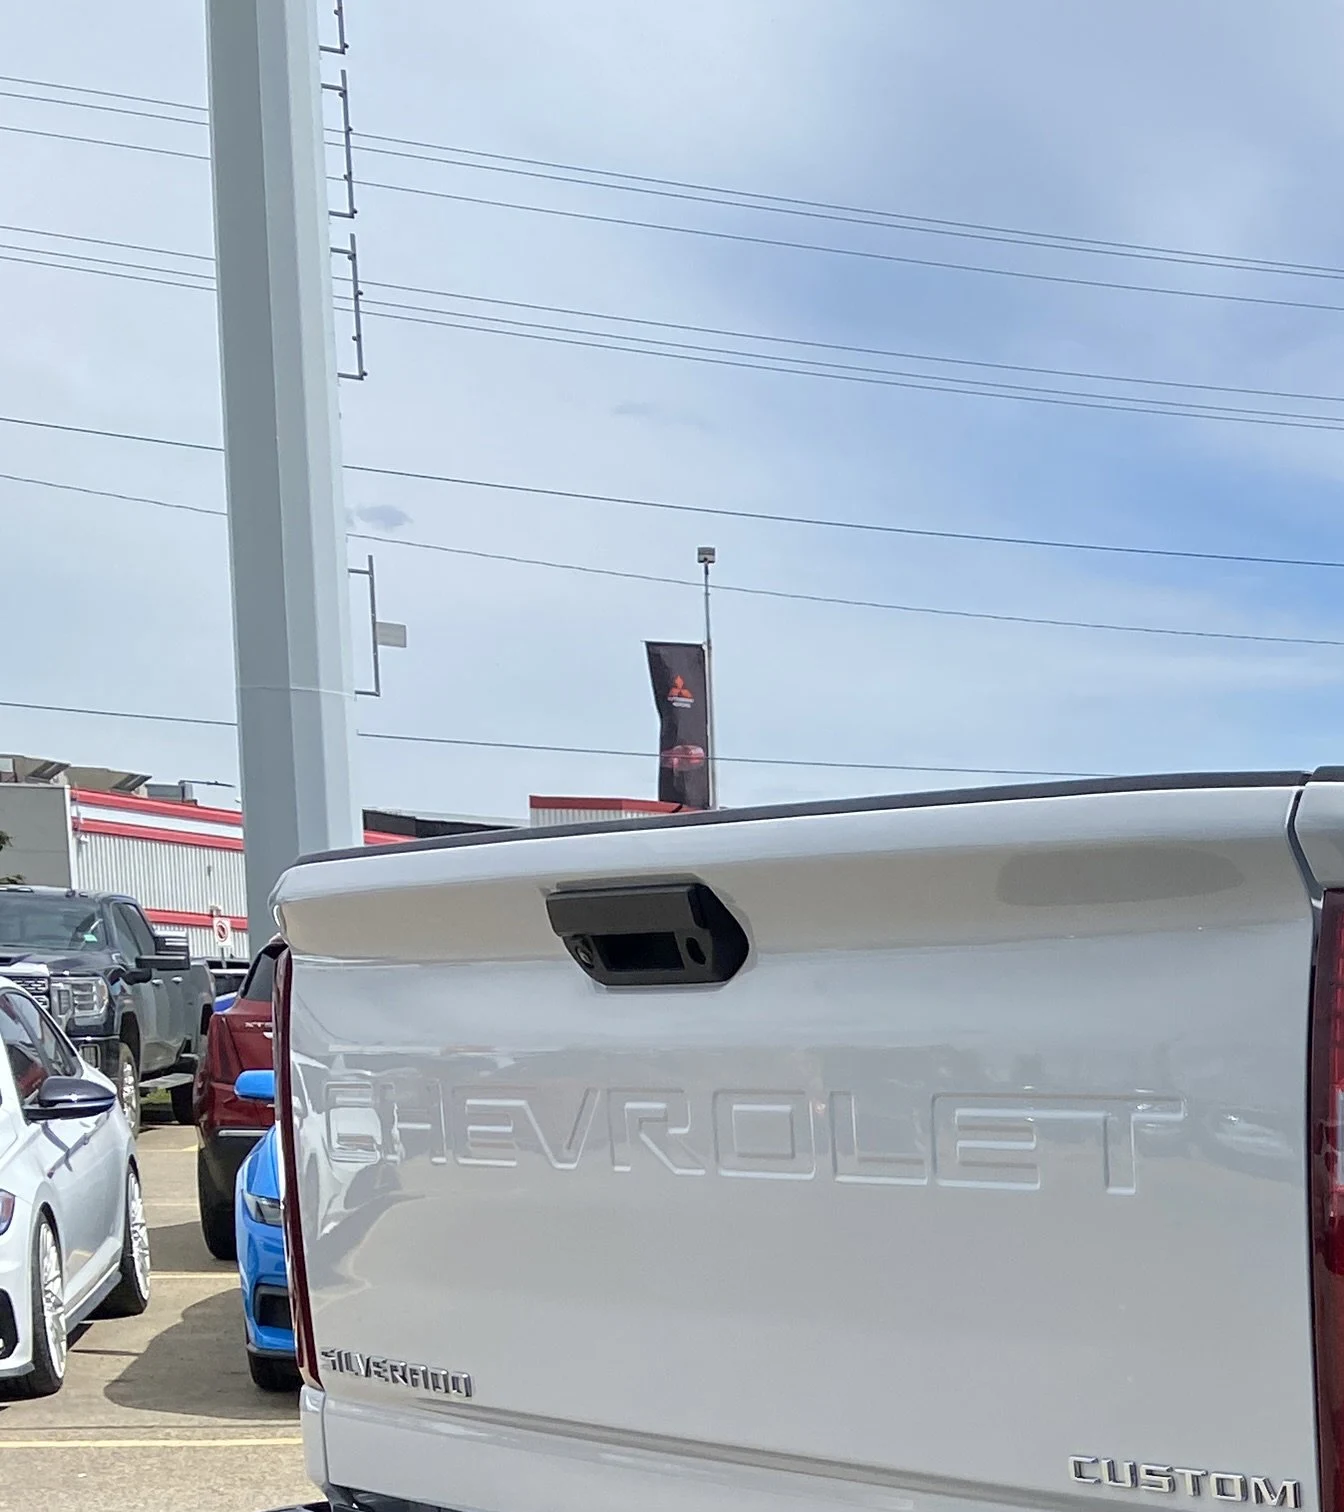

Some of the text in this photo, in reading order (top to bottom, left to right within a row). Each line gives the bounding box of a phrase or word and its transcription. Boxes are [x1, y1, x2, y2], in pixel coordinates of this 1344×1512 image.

[322, 1079, 1186, 1196] CHEVROLET
[320, 1347, 474, 1398] SILVERADO
[1068, 1454, 1302, 1509] CUSTOM
